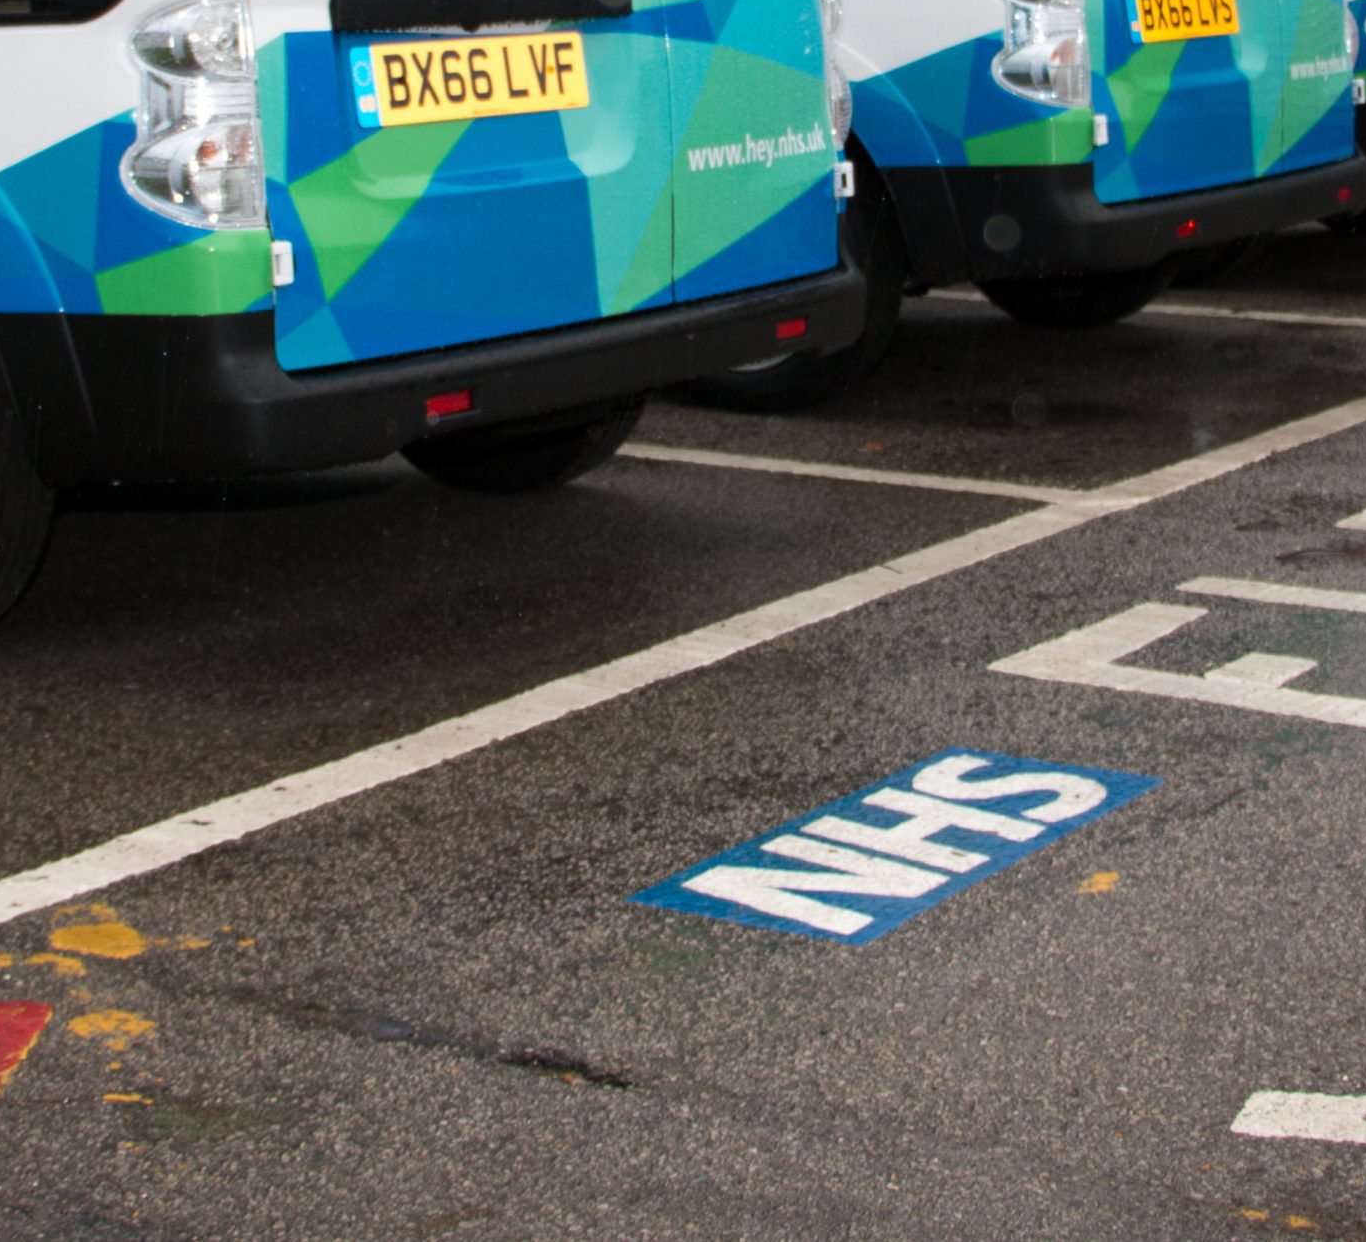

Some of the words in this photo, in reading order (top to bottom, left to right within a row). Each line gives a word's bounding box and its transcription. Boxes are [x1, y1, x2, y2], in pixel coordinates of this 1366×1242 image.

[383, 48, 493, 109] BX66
[502, 42, 573, 98] LVF
[688, 122, 828, 171] www.hey.nhs.uk
[680, 753, 1107, 937] NHS
